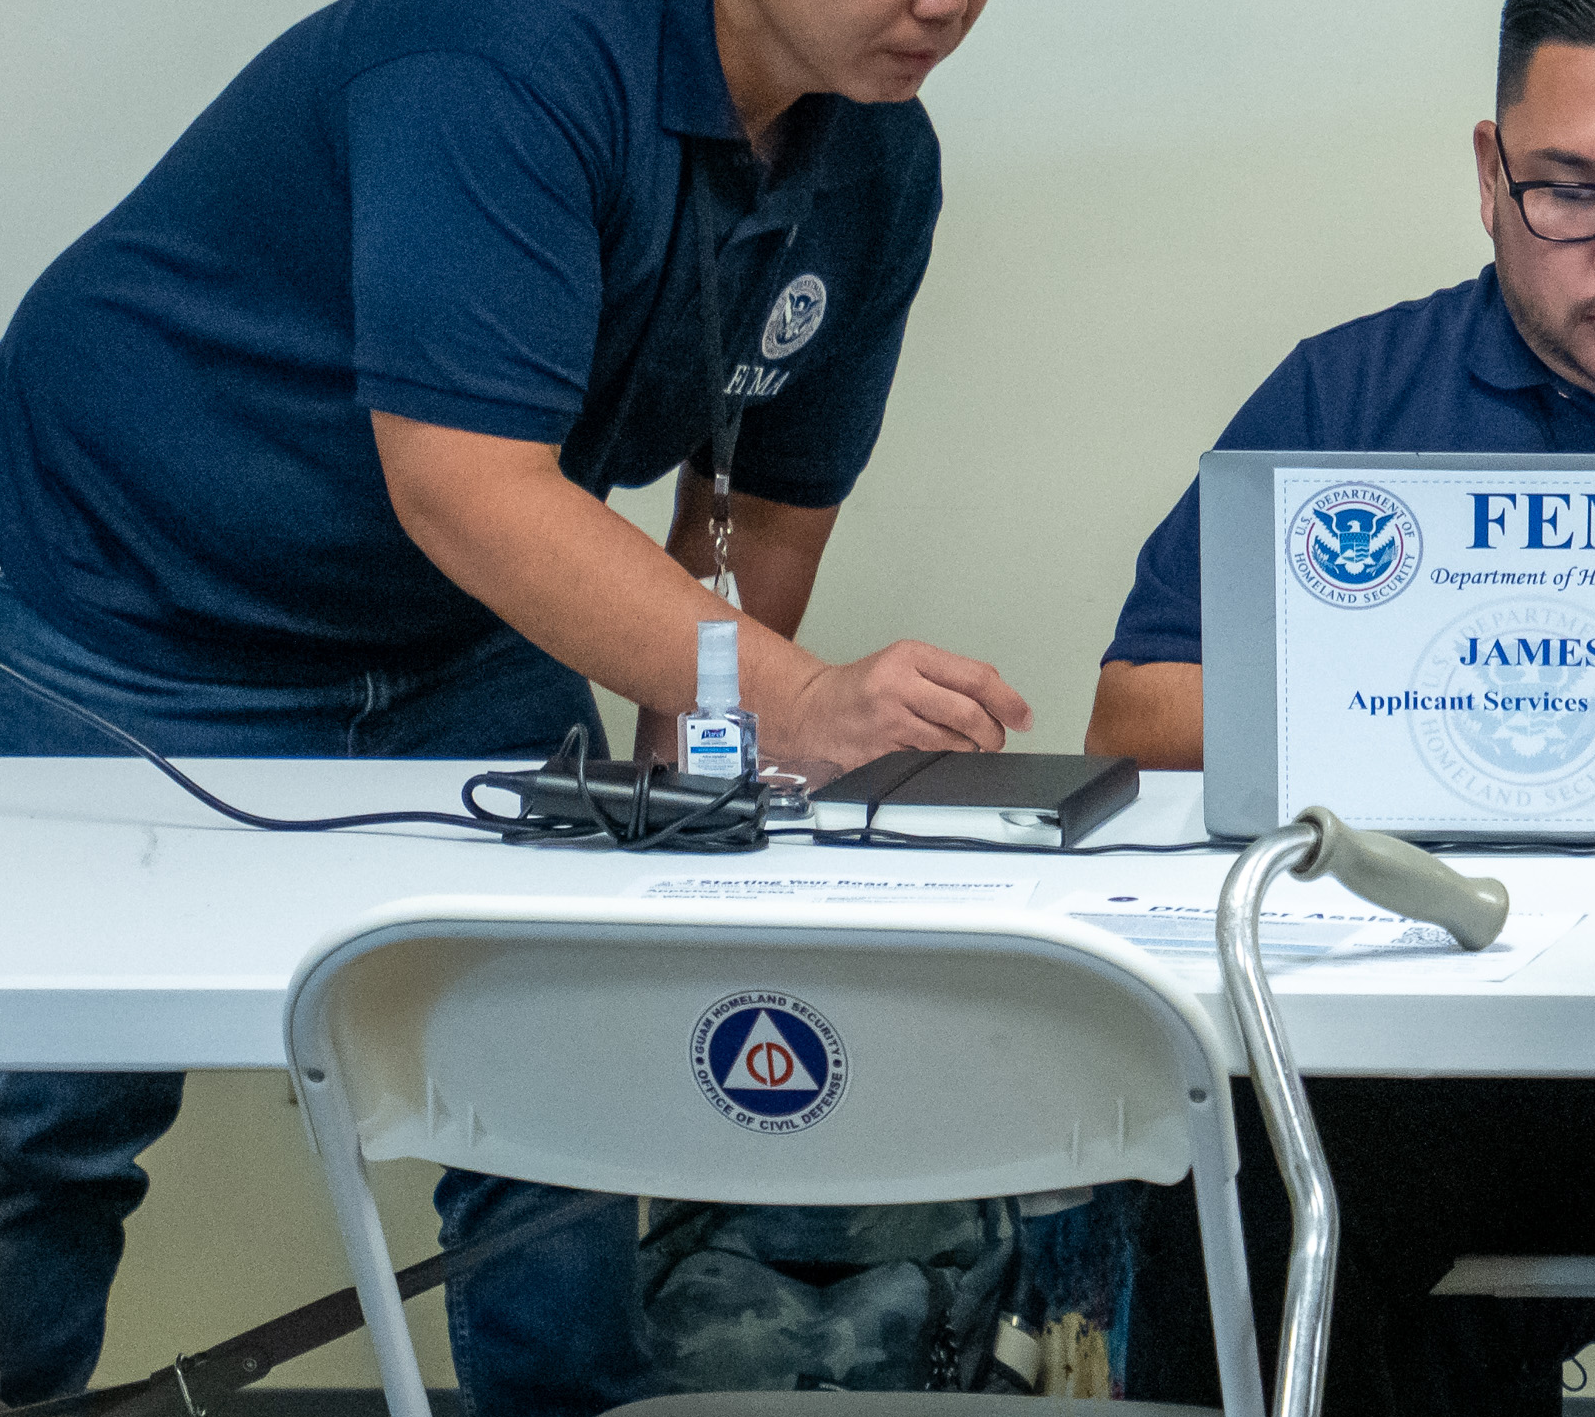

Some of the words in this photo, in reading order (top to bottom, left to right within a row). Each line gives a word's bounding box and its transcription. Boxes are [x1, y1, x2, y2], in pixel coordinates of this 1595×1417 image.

[1295, 516, 1312, 536] U.S.
[1315, 489, 1407, 520] DEPARTMENT
[1401, 521, 1416, 538] OF
[1294, 553, 1357, 604] HOMELAND
[1364, 554, 1416, 604] SECURITY
[1430, 567, 1547, 589] Department
[1552, 565, 1575, 592] of
[1348, 689, 1476, 716] Applicant
[1483, 689, 1589, 714] Services
[1148, 905, 1289, 918] Disaer
[1303, 912, 1419, 923] Assist
[695, 1017, 714, 1054] GUAM
[712, 994, 787, 1019] HOMELAND
[791, 1002, 842, 1056] SECURITY
[697, 1069, 734, 1112] OFFICE
[735, 1112, 755, 1125] OF
[759, 1119, 800, 1131] CIVIL
[801, 1073, 843, 1124] DEFENSE
